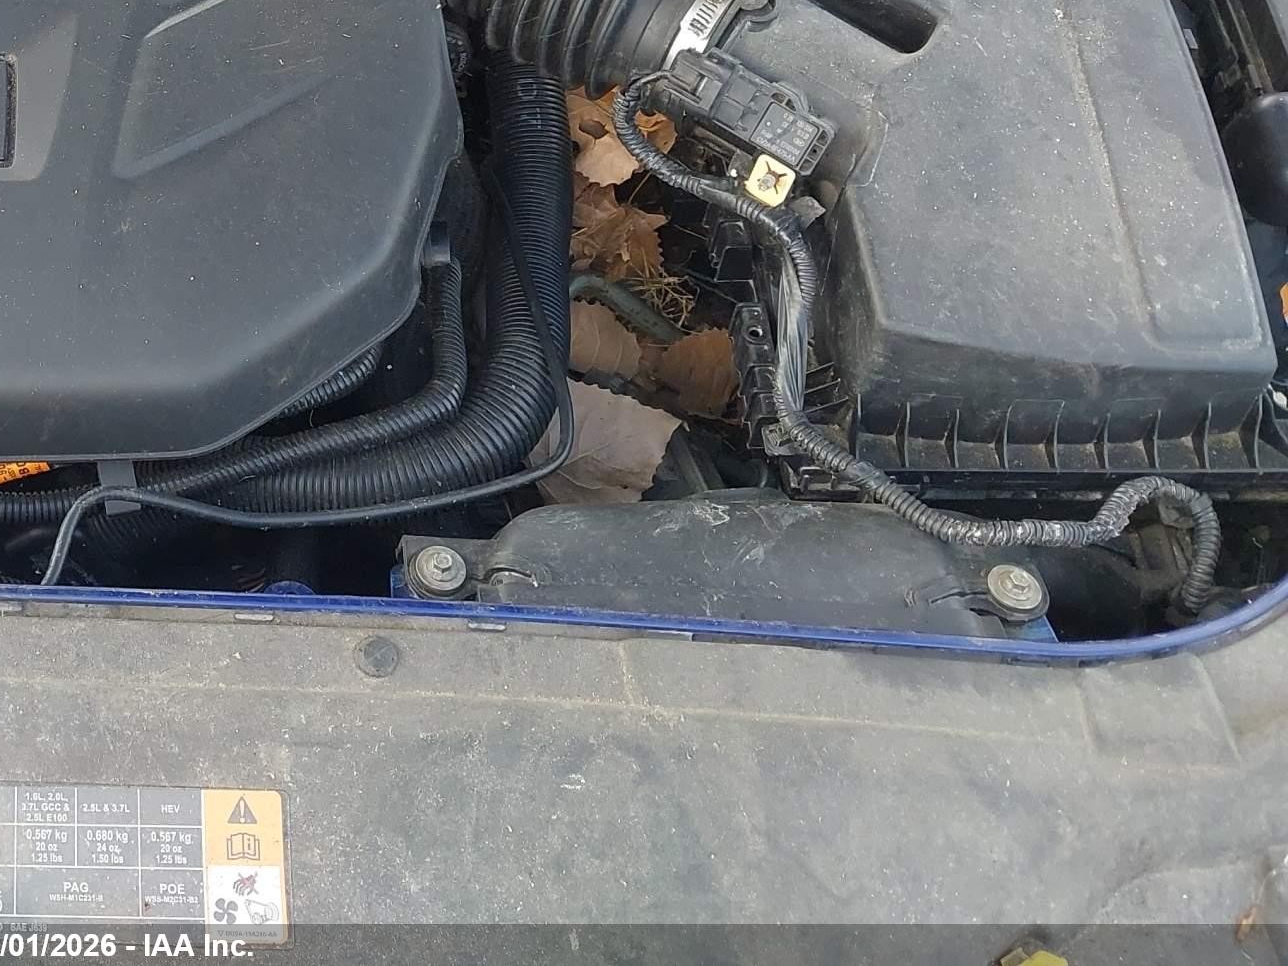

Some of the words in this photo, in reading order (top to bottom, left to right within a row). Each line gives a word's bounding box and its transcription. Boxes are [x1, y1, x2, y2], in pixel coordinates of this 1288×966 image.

[41, 802, 62, 812] GCC
[63, 802, 70, 812] &
[82, 803, 101, 812] 2.5L
[103, 803, 110, 812] &
[112, 803, 130, 813] 3.7L
[161, 804, 180, 813] HEV
[46, 813, 68, 822] E100
[26, 828, 52, 840] 0.567
[55, 828, 67, 843] kg
[86, 829, 113, 841] 0.680
[115, 829, 128, 844] kg
[151, 831, 177, 842] 0.567
[178, 831, 192, 845] kg
[35, 842, 46, 851] 20
[47, 843, 58, 851] oz
[96, 842, 107, 852] 24
[108, 844, 120, 853] oz
[160, 844, 171, 853] 20
[172, 845, 183, 853] oz
[31, 852, 48, 863] 1.25
[50, 852, 63, 863] lbs
[92, 853, 109, 864] 1.50
[110, 853, 124, 864] lbs
[155, 854, 173, 864] 1.25
[174, 854, 188, 865] lbs
[63, 882, 89, 893] PAG
[159, 883, 185, 895] POE
[10, 922, 28, 932] SAE
